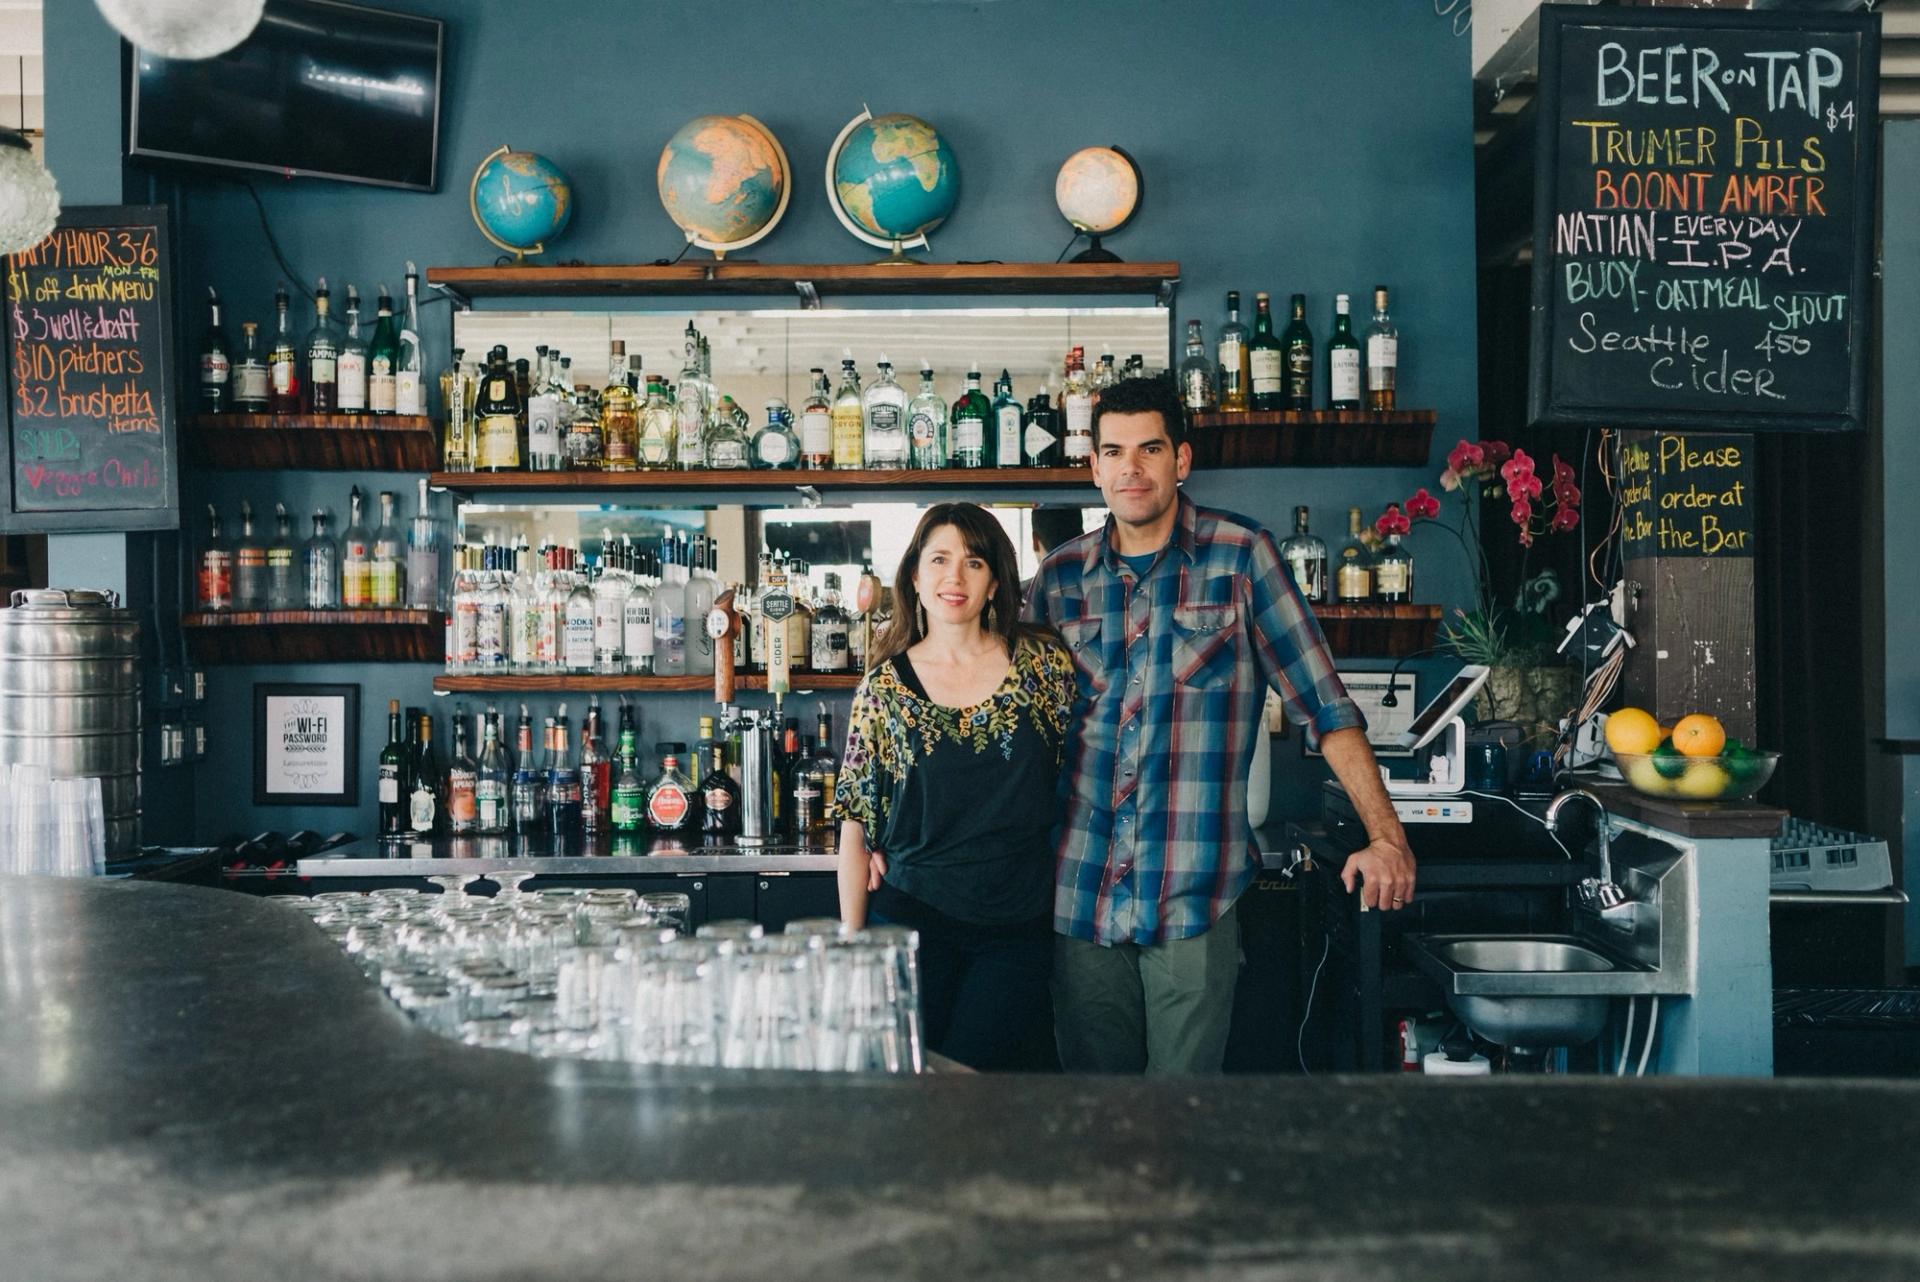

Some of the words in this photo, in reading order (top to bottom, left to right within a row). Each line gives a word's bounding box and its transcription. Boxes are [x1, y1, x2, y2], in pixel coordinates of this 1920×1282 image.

[1598, 43, 1730, 114] BEER
[1745, 48, 1843, 119] TAP
[1826, 100, 1855, 133] $4
[1572, 121, 1717, 167] TRUMER
[1736, 118, 1826, 173] PILS
[1595, 170, 1713, 211] BOONT
[1720, 174, 1826, 217] AMBER
[65, 229, 118, 267] HOUR
[117, 232, 158, 266] 3-6
[1667, 240, 1807, 276] I.P.A.
[8, 270, 29, 303] $1
[36, 277, 61, 302] off
[1655, 276, 1769, 311] OATMEAL
[50, 308, 83, 341] well
[93, 306, 140, 342] draft
[1569, 313, 1710, 362] Seattle
[13, 342, 55, 383] $10
[58, 378, 156, 419] brushetta
[108, 416, 160, 434] items
[1623, 448, 1650, 475] Please
[1660, 435, 1742, 476] Please
[1660, 484, 1717, 509] order
[1720, 481, 1745, 507] at
[1636, 511, 1653, 541] Bar
[1657, 518, 1699, 549] the
[1701, 515, 1748, 553] Bar
[627, 616, 651, 624] VODKA
[766, 600, 788, 608] SEATTLE
[283, 733, 327, 744] PASSWORD
[297, 717, 327, 733] WI-FI
[582, 772, 590, 806] TUACA
